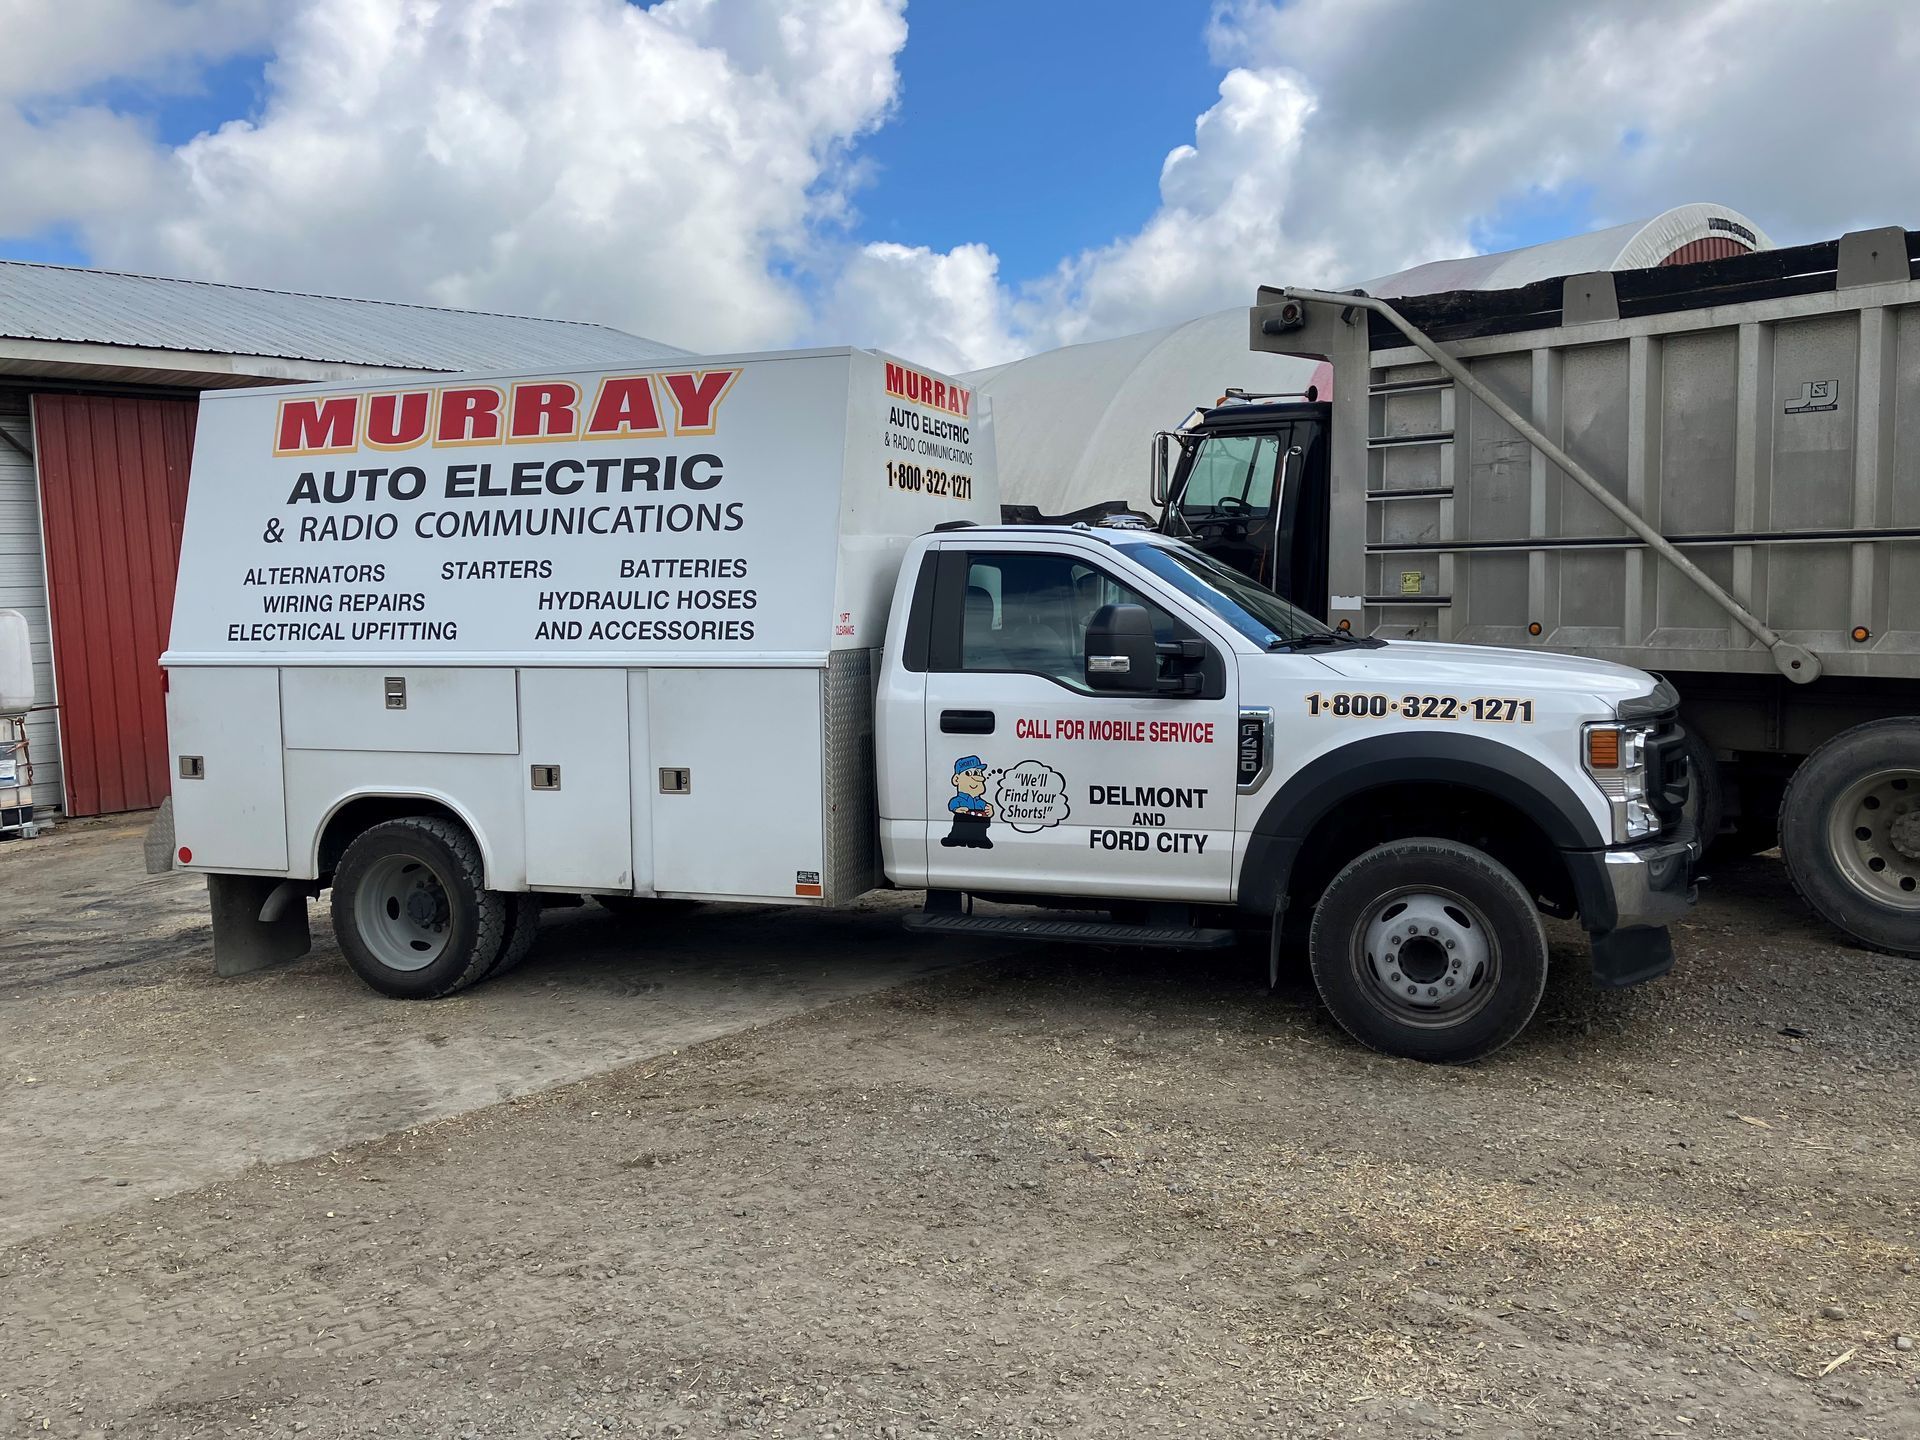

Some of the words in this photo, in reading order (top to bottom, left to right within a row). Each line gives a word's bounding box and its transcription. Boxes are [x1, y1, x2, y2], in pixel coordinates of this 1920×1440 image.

[885, 361, 970, 419] MURRAY
[272, 368, 744, 458] MURRAY
[889, 406, 919, 431] AUTO
[922, 416, 970, 444] ELECTRIC
[884, 432, 890, 446] &
[893, 433, 915, 453] RADIO
[918, 440, 973, 465] COMMUNICATIONS
[286, 466, 427, 505] AUTO
[445, 454, 724, 499] ELECTRIC
[263, 517, 285, 543] &
[299, 513, 399, 542] RADIO
[414, 503, 744, 539] COMMUNICATIONS
[243, 564, 386, 586] ALTERNATORS
[441, 560, 553, 581] STARTERS
[620, 558, 748, 579] BATTERIES
[263, 594, 333, 613] WIRING
[338, 593, 426, 612] REPAIRS
[538, 590, 670, 610] HYDRAULIC
[677, 589, 758, 610] HOSES
[227, 622, 346, 642] ELECTRICAL
[351, 621, 458, 641] UPFITTING
[534, 621, 583, 640] AND
[588, 620, 755, 640] ACCESSORIES
[1016, 718, 1052, 739] CALL
[1056, 719, 1085, 740] FOR
[1089, 720, 1145, 742] MOBILE
[1149, 721, 1214, 744] SERVICE
[1004, 789, 1029, 803] Find
[1031, 790, 1057, 804] Your
[1089, 785, 1209, 809] DELMONT
[1132, 812, 1166, 827] AND
[1089, 829, 1150, 852] FORD
[1156, 832, 1209, 854] CITY
